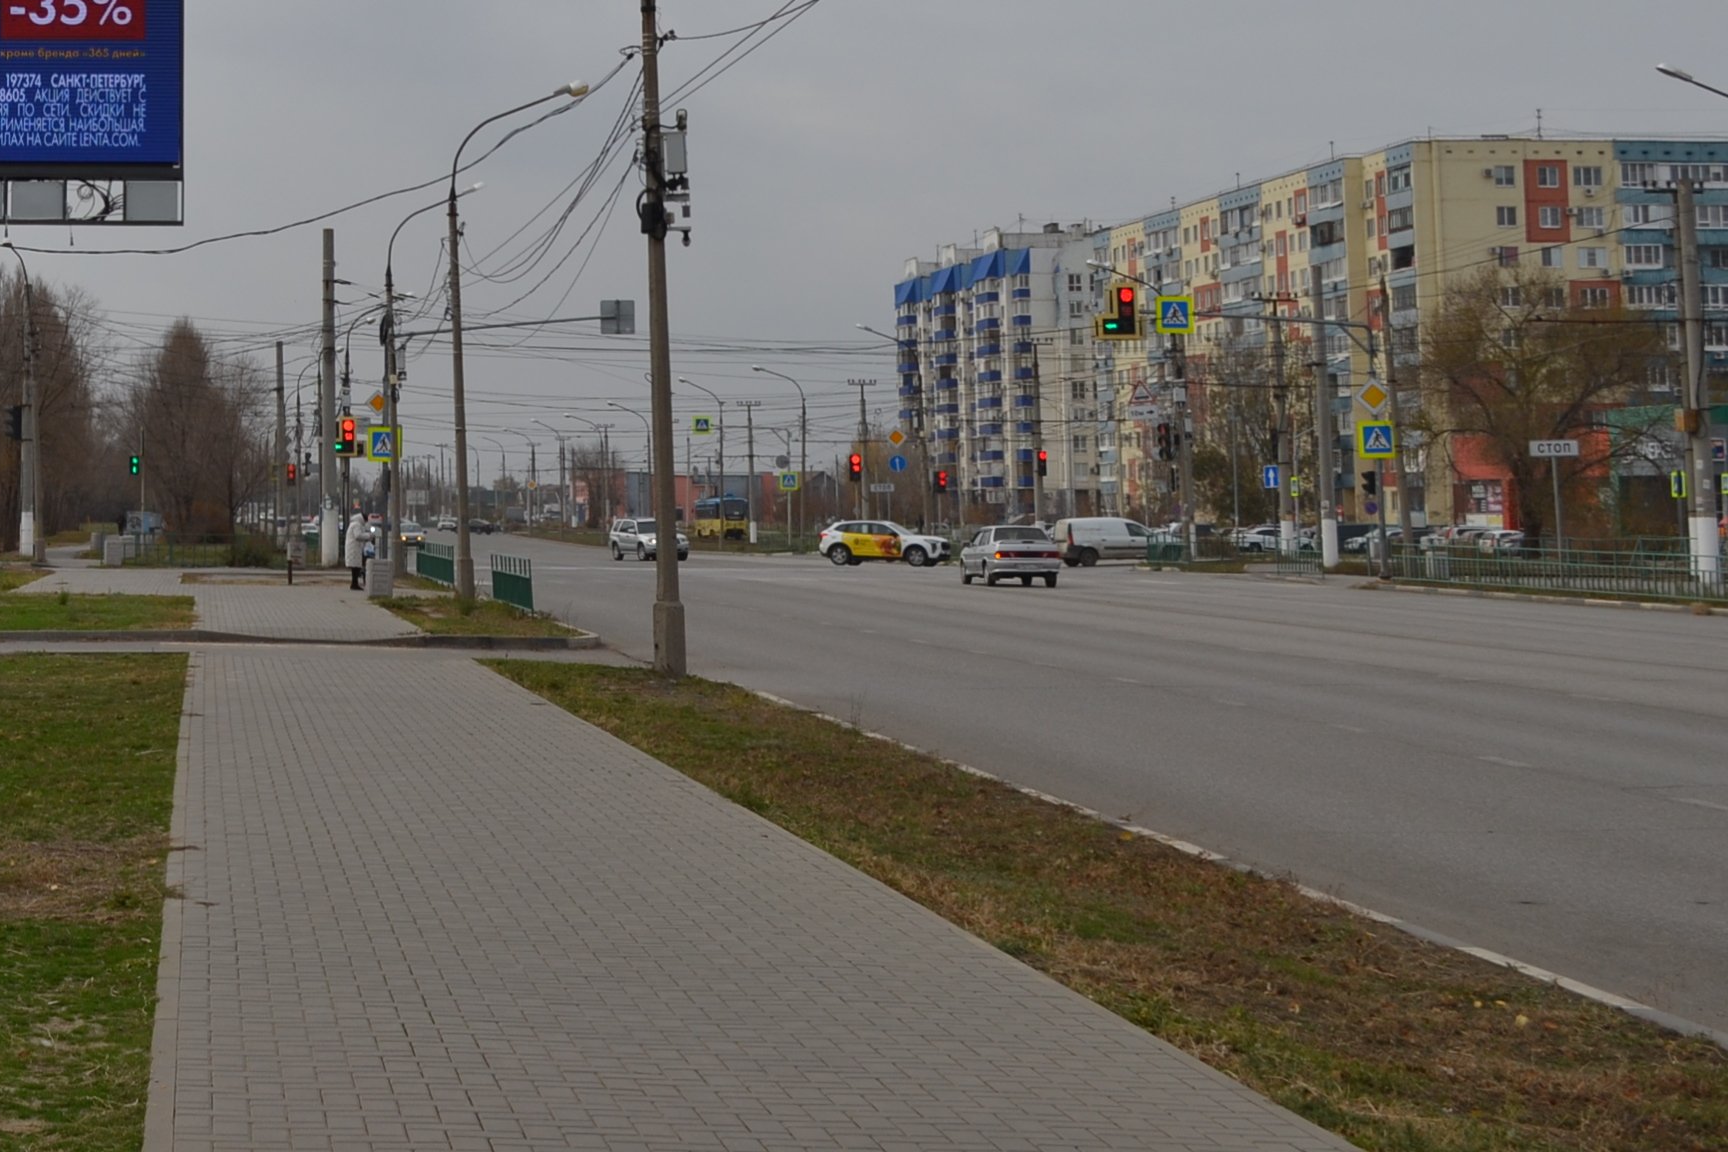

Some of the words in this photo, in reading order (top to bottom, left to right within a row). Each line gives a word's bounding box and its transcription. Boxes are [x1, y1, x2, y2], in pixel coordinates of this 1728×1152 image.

[5, 74, 42, 88] 197374
[34, 88, 70, 102] АКЦИЯ
[138, 88, 146, 102] С
[17, 103, 35, 117] ПО
[79, 103, 125, 117] СКИДКИ
[133, 103, 146, 117] НЕ
[26, 133, 42, 147] НА
[1537, 443, 1571, 454] СТОП
